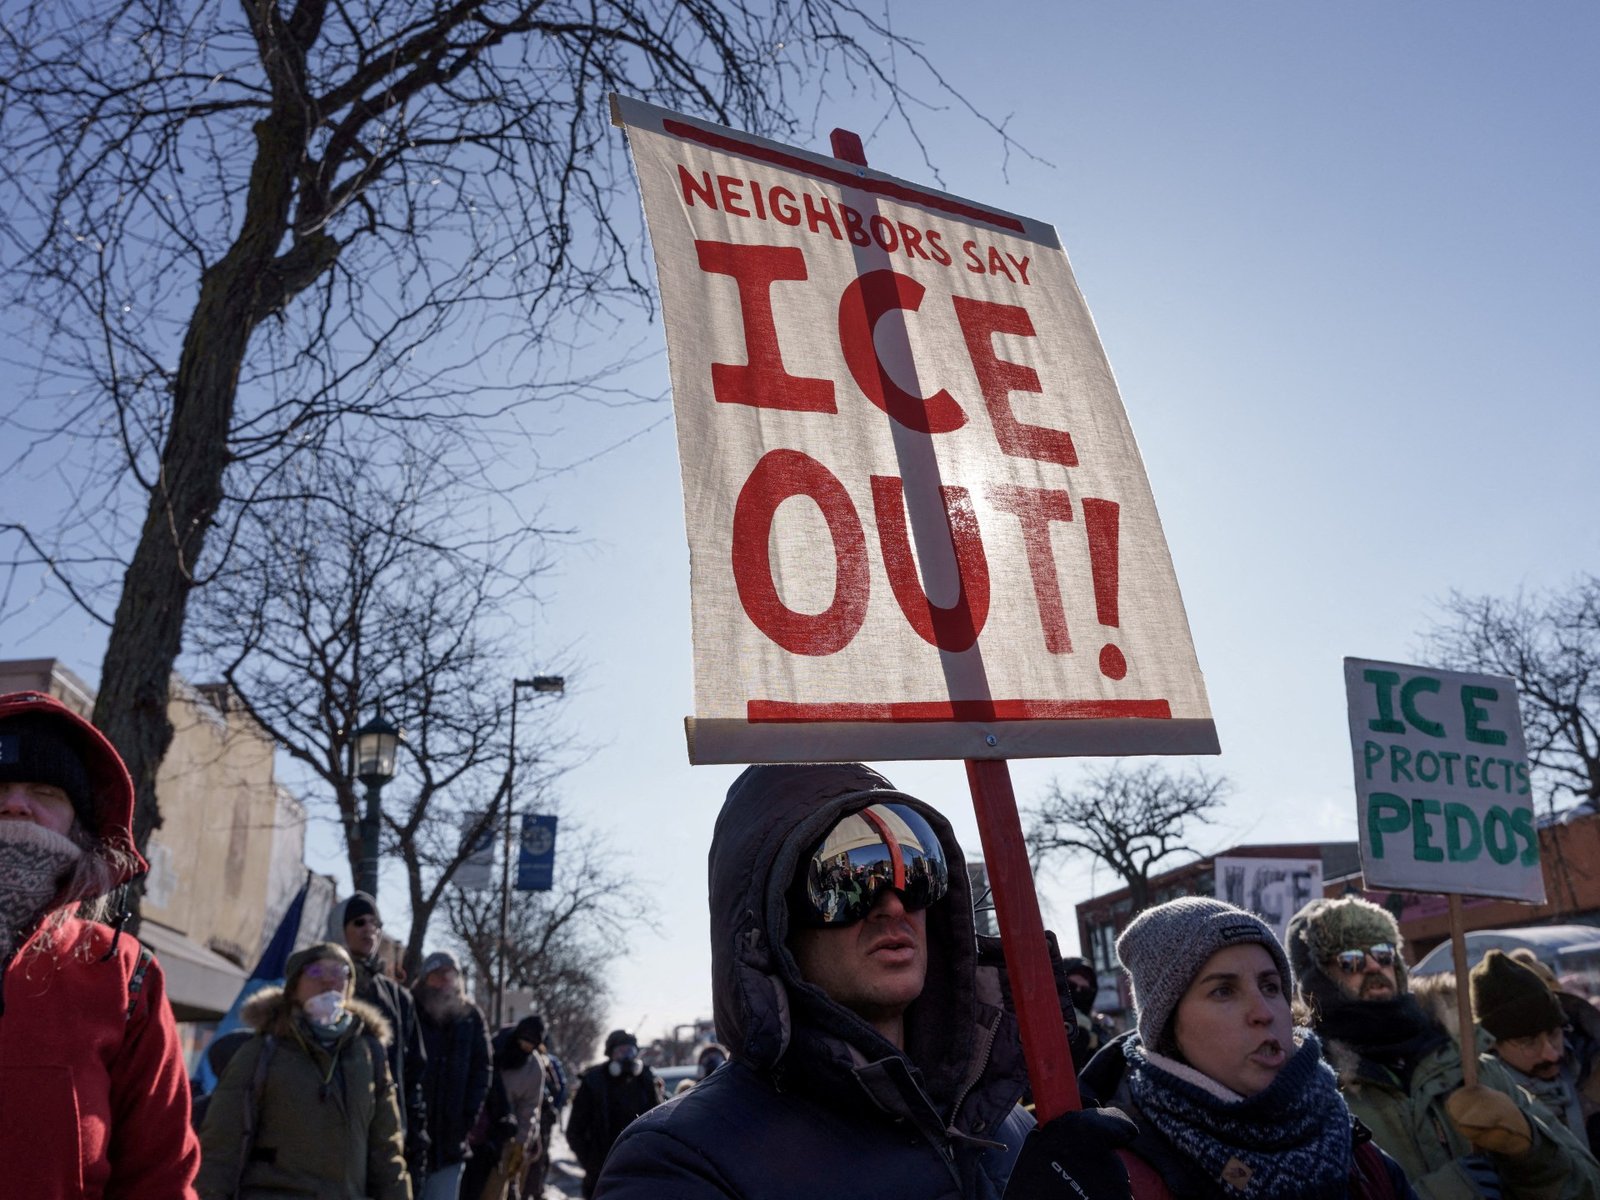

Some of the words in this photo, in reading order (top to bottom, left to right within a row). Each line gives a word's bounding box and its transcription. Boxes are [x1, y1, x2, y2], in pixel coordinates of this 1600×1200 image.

[677, 163, 952, 267] NEIGHBORS
[962, 240, 1031, 286] SAY
[694, 239, 1078, 467] ICE
[731, 448, 1127, 680] OUT!
[1363, 669, 1507, 746] ICE
[1363, 740, 1531, 795] PROTECTS
[1367, 791, 1540, 867] PEDOS
[1051, 1161, 1090, 1200] HEAD
